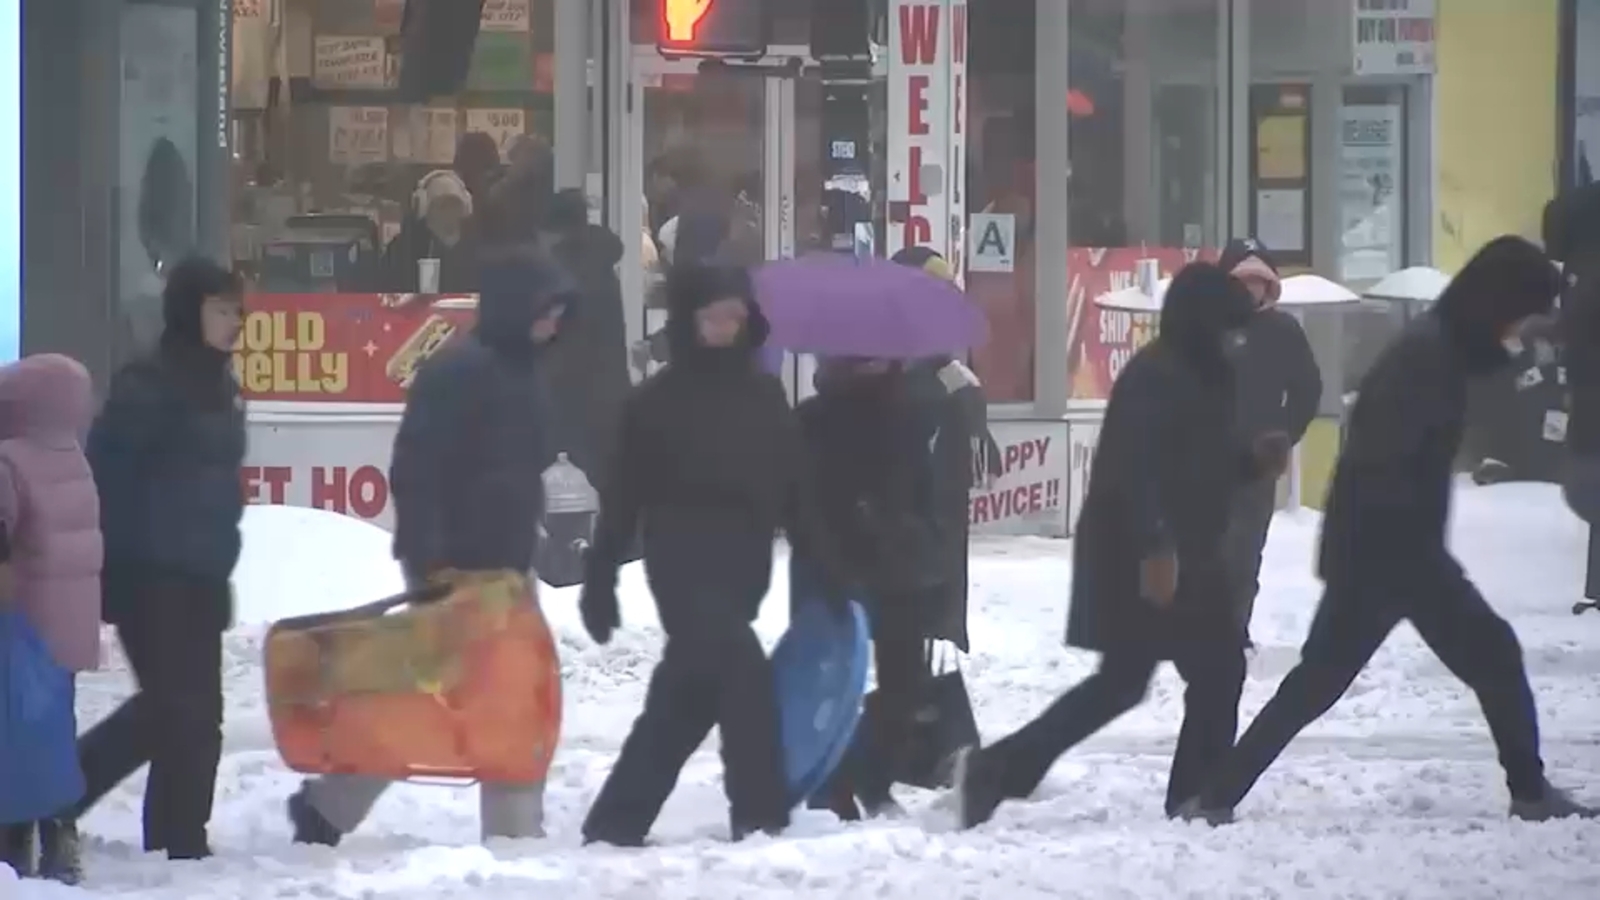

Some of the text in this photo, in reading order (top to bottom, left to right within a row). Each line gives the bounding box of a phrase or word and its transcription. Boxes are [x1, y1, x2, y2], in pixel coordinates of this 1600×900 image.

[977, 219, 1006, 256] A
[1099, 309, 1131, 343] SHIP
[996, 436, 1051, 478] PPY
